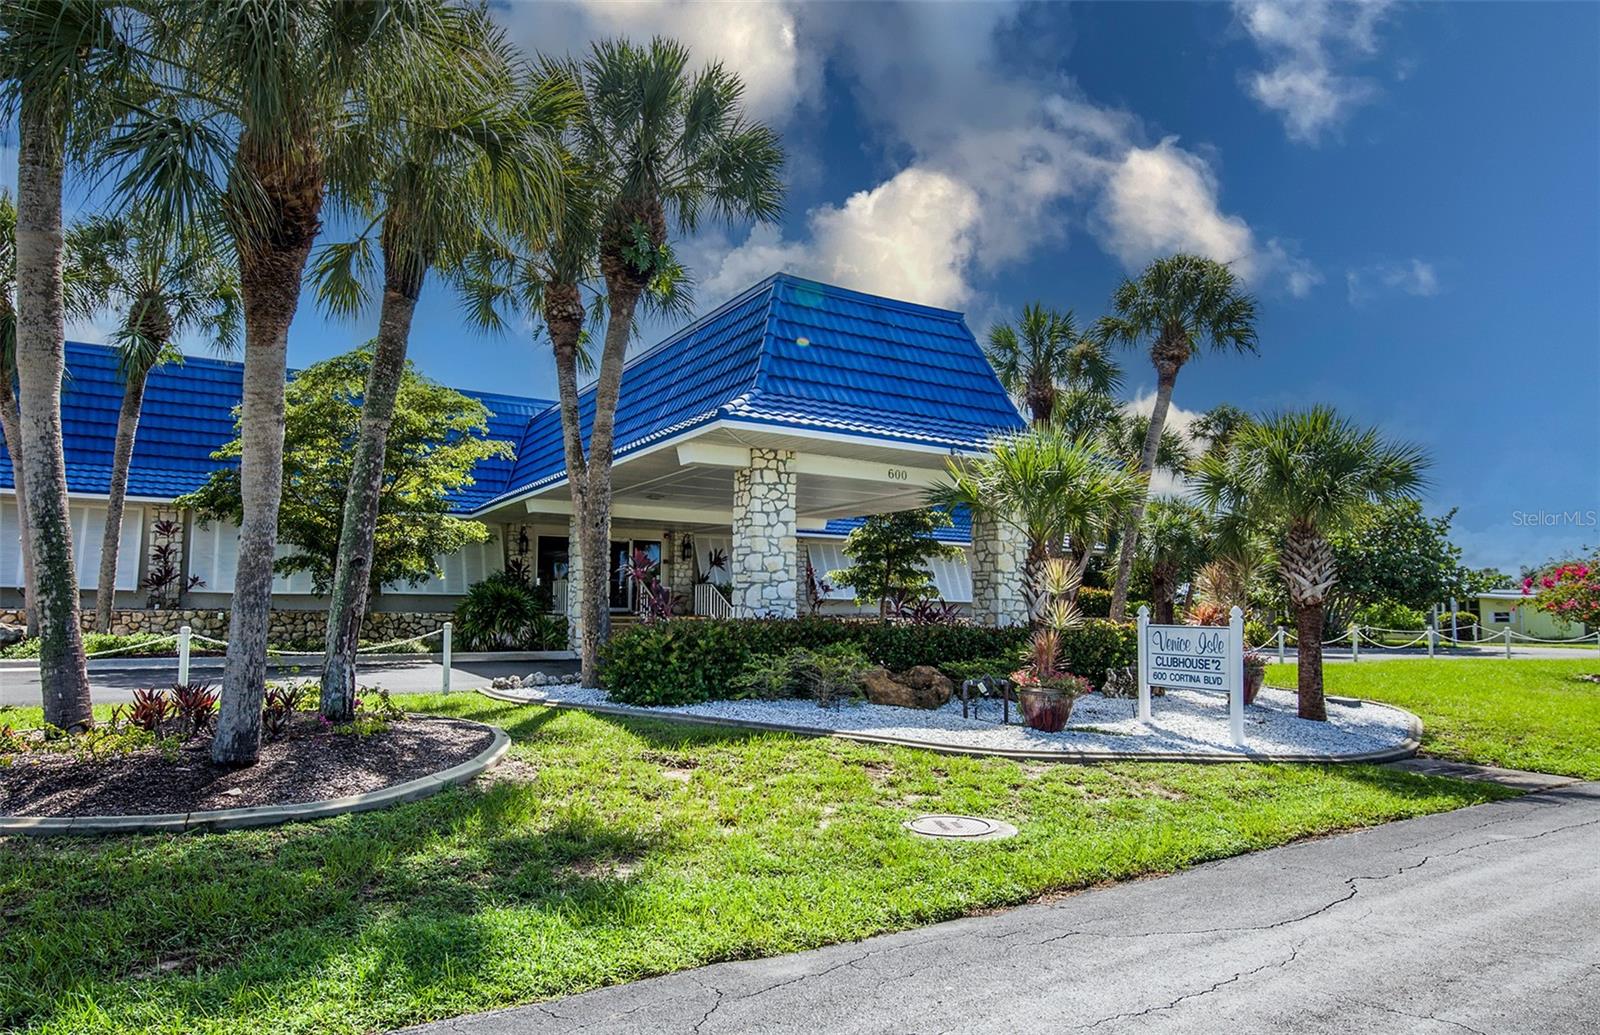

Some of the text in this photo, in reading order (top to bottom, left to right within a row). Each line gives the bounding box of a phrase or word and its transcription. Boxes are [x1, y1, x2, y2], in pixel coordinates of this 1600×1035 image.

[888, 468, 907, 480] 600
[1152, 630, 1225, 655] Venice Isle
[1155, 655, 1210, 670] CLUBHOUSE
[1152, 671, 1223, 685] 600 CORTINA BLVD
